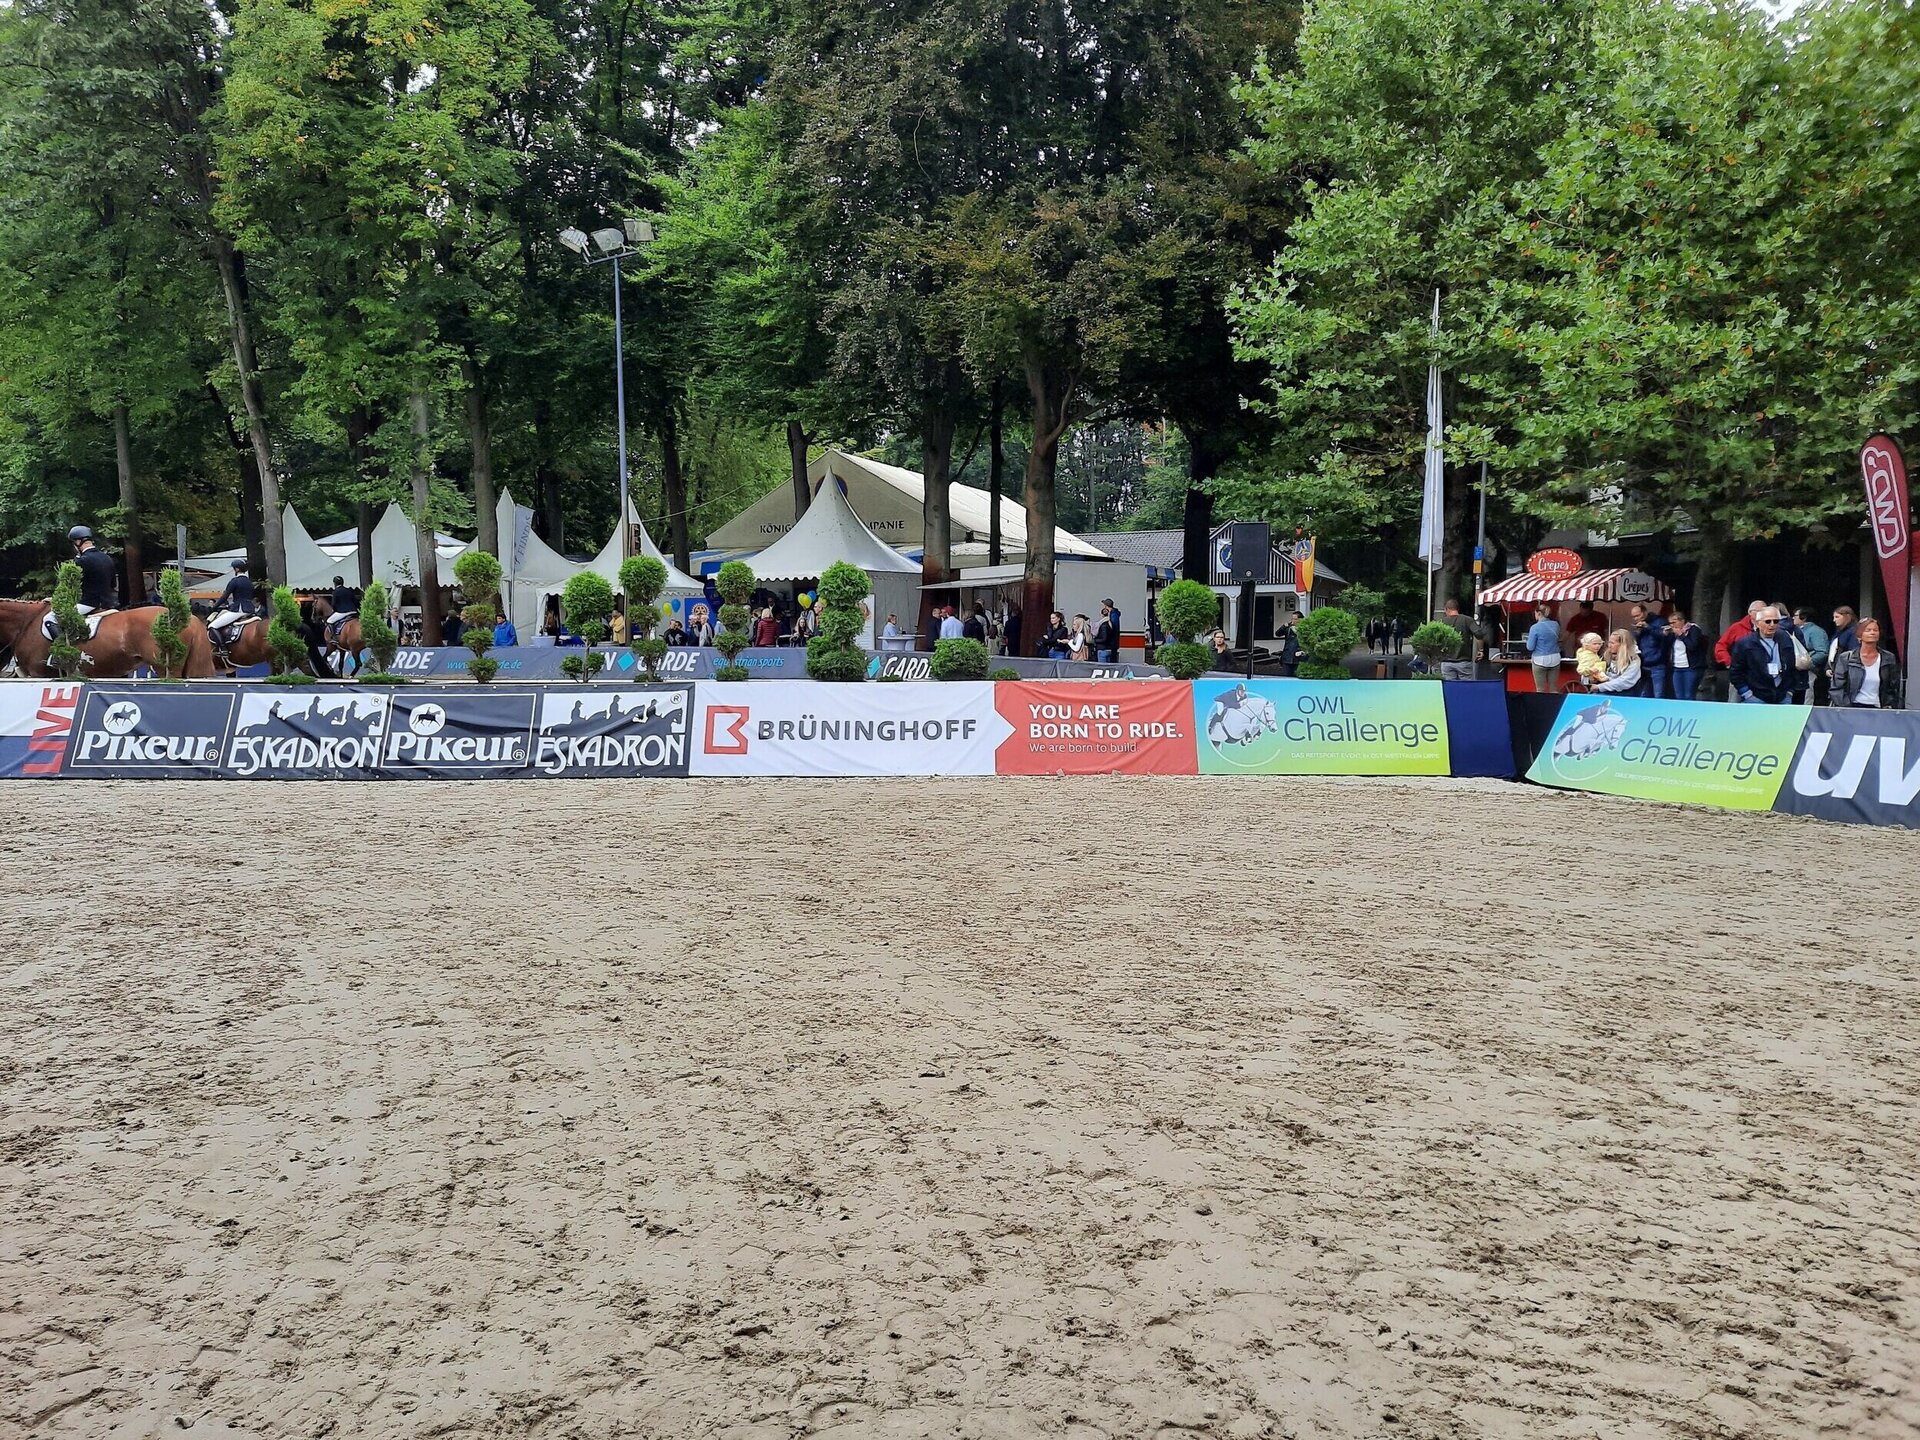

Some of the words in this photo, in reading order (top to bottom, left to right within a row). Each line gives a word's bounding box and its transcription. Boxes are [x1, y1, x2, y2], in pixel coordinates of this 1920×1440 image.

[760, 523, 793, 534] KÖNIG
[1538, 557, 1570, 573] Crêpes
[1623, 578, 1649, 596] Crêpes
[386, 651, 435, 670] RDE
[712, 656, 757, 668] equstrian
[1028, 703, 1072, 719] YOU
[1078, 704, 1120, 719] ARE
[1296, 695, 1355, 715] OWL
[22, 686, 80, 774] LIVE
[758, 714, 977, 741] BRÜNINGHOFF
[1029, 723, 1089, 738] BORN
[1094, 723, 1123, 738] TO
[1129, 722, 1184, 738] RIDE.
[1283, 717, 1439, 747] Challenge
[1647, 715, 1701, 739] OWL
[227, 735, 383, 775] ESKADRON
[534, 734, 686, 774] ESKADRON
[1029, 743, 1046, 753] We
[1048, 745, 1065, 753] are
[1068, 743, 1093, 753] born
[1096, 743, 1107, 753] to
[1620, 737, 1779, 781] Challenge
